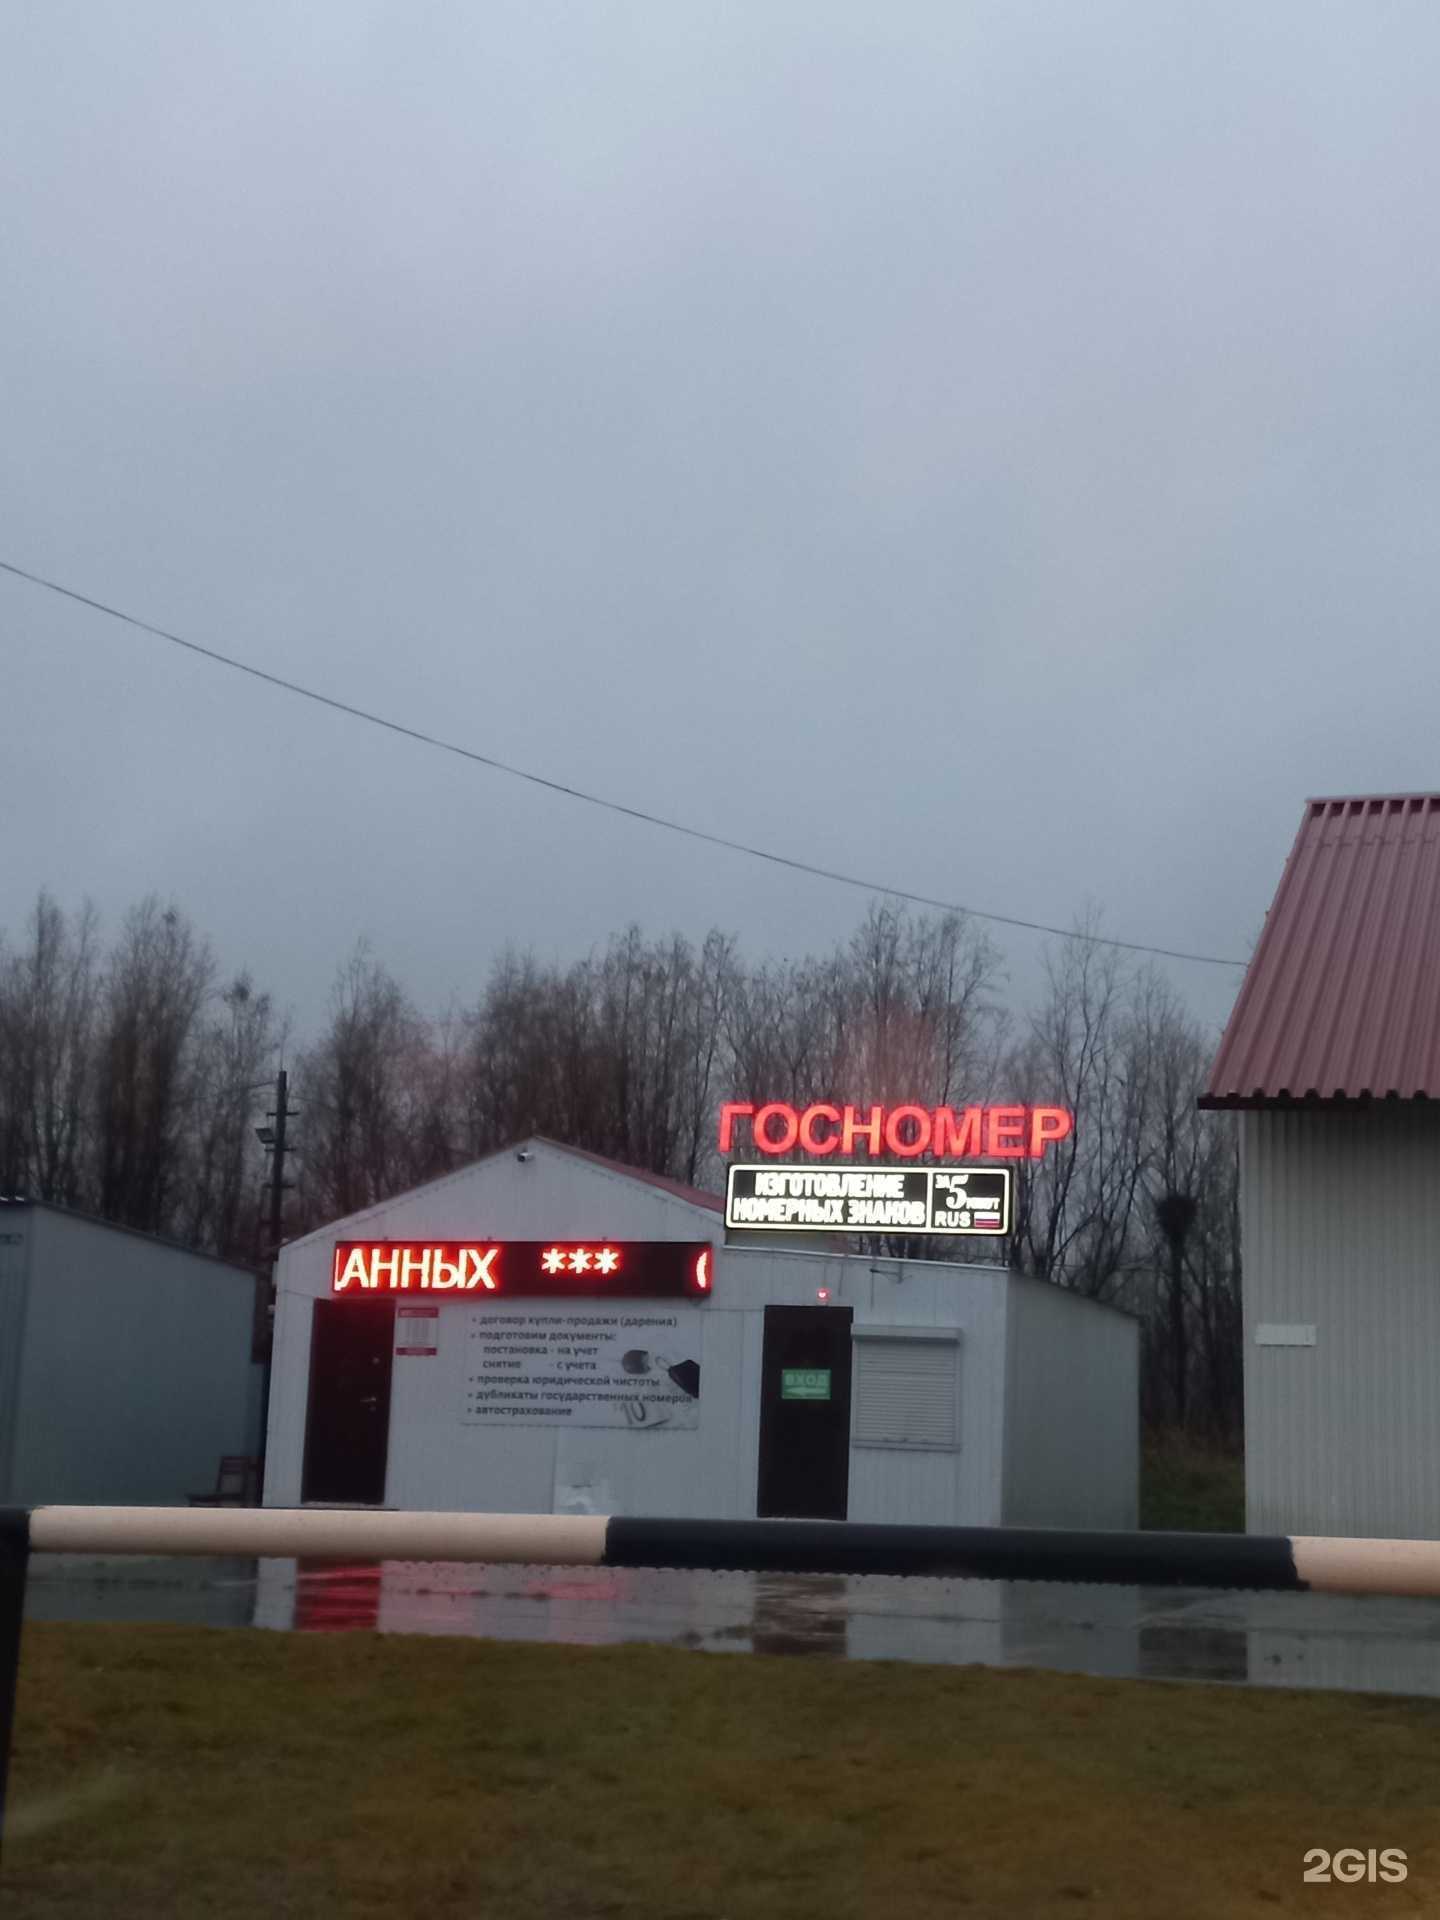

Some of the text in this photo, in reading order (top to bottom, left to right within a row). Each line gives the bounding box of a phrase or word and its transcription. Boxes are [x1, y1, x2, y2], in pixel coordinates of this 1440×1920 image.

[719, 1103, 1073, 1158] ГОСНОМЕР
[755, 1172, 905, 1198] ИЗГОТОВЛЕНИЕ
[946, 1174, 969, 1210] 5
[733, 1197, 926, 1225] НОМЕРНЫХ ЗНАКОВ
[935, 1210, 971, 1228] RUS
[334, 1248, 498, 1290] АННЫХ
[480, 1316, 526, 1326] договор
[479, 1331, 547, 1341] подготовим
[483, 1345, 548, 1355] постановка
[573, 1347, 599, 1358] учет
[482, 1360, 521, 1369] снятие
[565, 1361, 597, 1372] учета
[477, 1376, 530, 1386] проверка
[532, 1375, 611, 1386] юридической
[475, 1390, 539, 1401] дубликаты
[475, 1406, 572, 1417] автострахование
